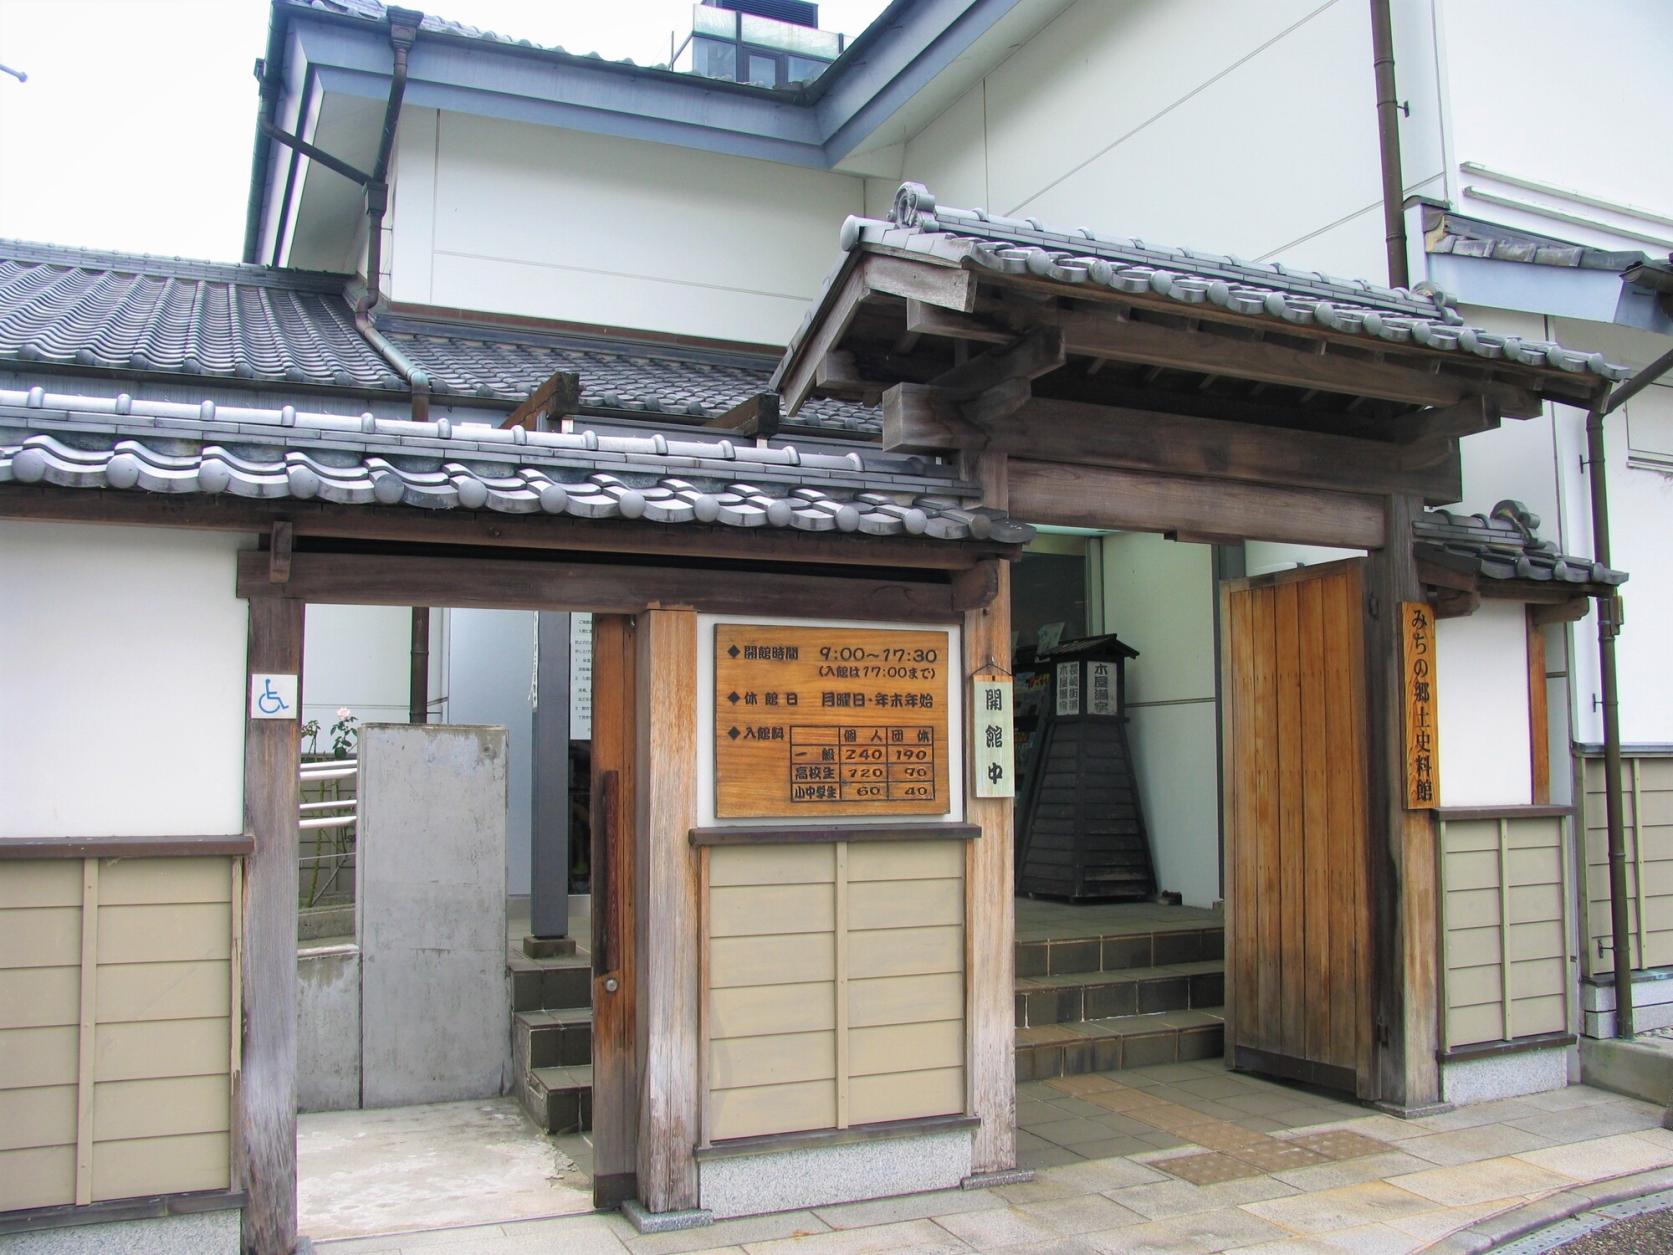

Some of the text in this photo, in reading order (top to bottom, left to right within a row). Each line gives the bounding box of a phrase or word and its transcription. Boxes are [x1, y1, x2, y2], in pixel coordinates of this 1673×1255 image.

[744, 645, 799, 660] 開館時間
[1411, 610, 1433, 802] みちの郷土史料館
[743, 726, 785, 741] 入館料
[984, 688, 1003, 785] 開館中
[845, 749, 882, 761] 240
[896, 749, 927, 761] 190
[794, 766, 927, 780] 高校生 120 90
[793, 785, 928, 799] 小中学生 60 40
